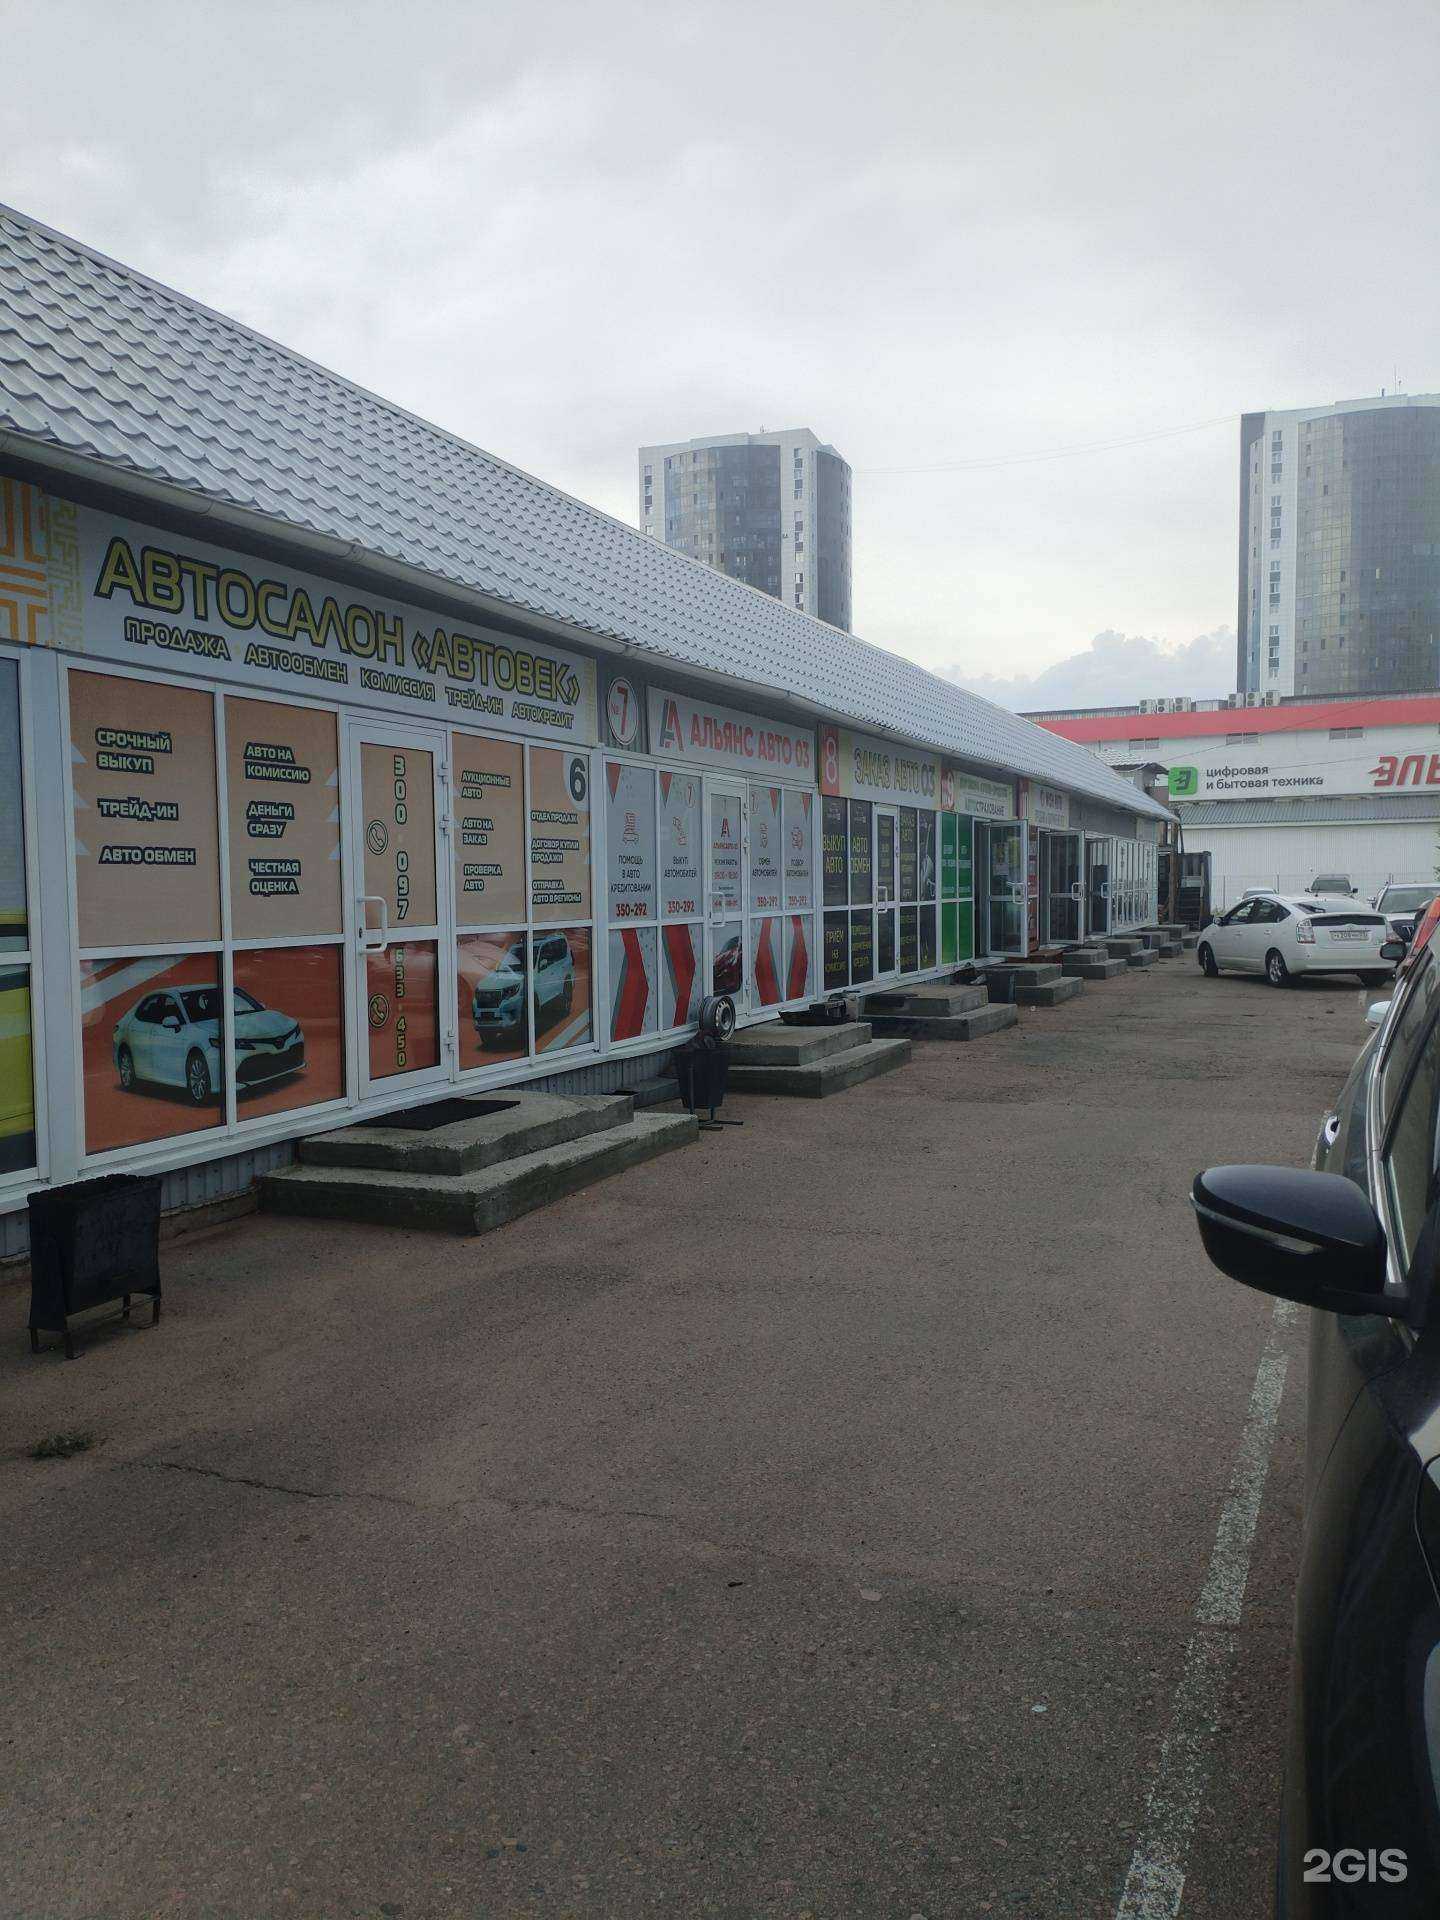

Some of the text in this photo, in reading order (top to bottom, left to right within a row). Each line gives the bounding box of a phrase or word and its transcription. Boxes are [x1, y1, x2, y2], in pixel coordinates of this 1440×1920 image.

[94, 536, 404, 667] АВТОСАЛОН
[124, 616, 574, 729] ПРОДАЖА АВТООБМЕН КОМИССИЯ ТРЕЙД-ИН АВТОКРЕДИТ
[95, 727, 172, 753] СРОЧНЫЙ
[690, 713, 810, 768] АЛЬЯНС АВТО 03
[244, 742, 295, 764] АВТО НА
[826, 736, 837, 784] 8
[96, 751, 154, 774] ВЫКУП
[245, 761, 311, 784] КОМИССИЮ
[461, 770, 511, 787] АУКЦИОННЫЕ
[569, 758, 586, 801] 6
[854, 747, 891, 790] ЗАКАЗ
[893, 758, 920, 793] АВТО
[921, 763, 935, 798] 03
[1206, 766, 1269, 778] цифровая
[1206, 776, 1323, 790] и бытовая техника
[462, 787, 482, 799] АВТО
[98, 797, 178, 821] ТРЕЙД-ИН
[246, 801, 295, 820] ДЕНЬГИ
[531, 810, 551, 822] ОТДЕЛ
[247, 821, 287, 838] СРАЗУ
[463, 818, 494, 831] АВТО НА
[463, 833, 487, 845] ЗАКАЗ
[822, 834, 846, 852] ВЫКУП
[852, 836, 868, 853] АВТО
[99, 846, 196, 865] АВТО ОБМЕН
[618, 855, 643, 865] ПОМОЩЬ
[249, 859, 301, 876] ЧЕСТНАЯ
[464, 864, 502, 876] ПРОВЕРКА
[825, 856, 843, 874] АВТО
[851, 857, 871, 874] ОБМЕН
[627, 870, 641, 879] АВТО
[250, 878, 300, 896] ОЦЕНКА
[464, 879, 484, 891] АВТО
[532, 880, 564, 890] ОТПРАВКА
[611, 883, 651, 893] КРЕДИТОВАНИИ
[532, 893, 549, 904] АВТО
[668, 900, 695, 913] 350-292
[616, 902, 647, 917] 350-292
